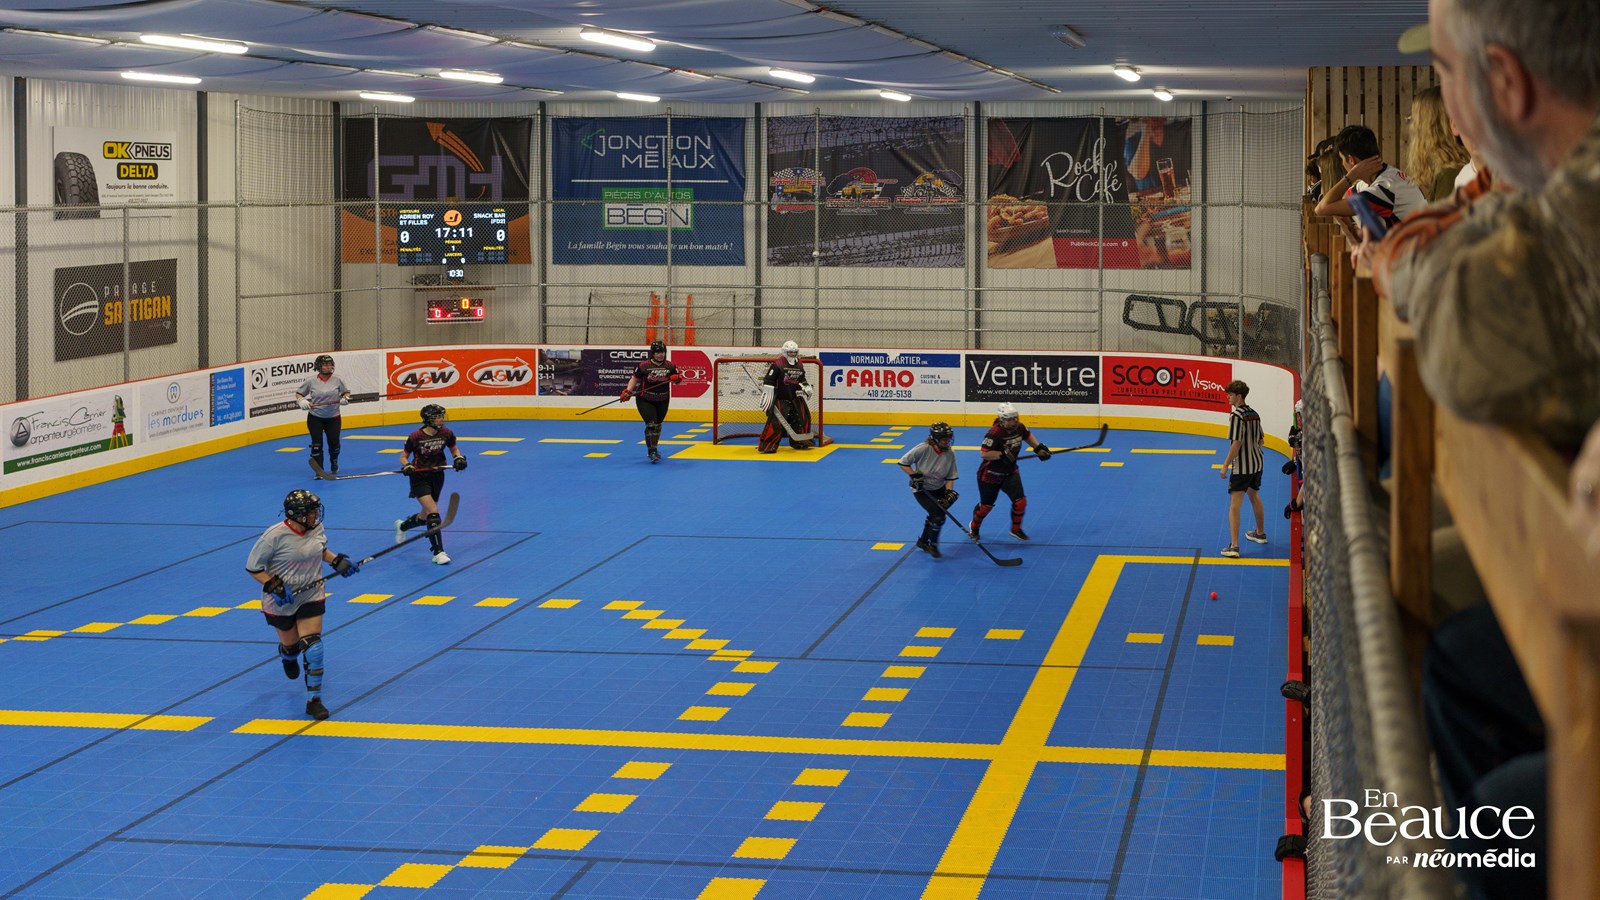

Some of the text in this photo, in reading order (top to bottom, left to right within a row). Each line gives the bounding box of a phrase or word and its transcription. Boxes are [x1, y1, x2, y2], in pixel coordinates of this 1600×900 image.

[103, 142, 170, 158] OK PNEUS
[120, 165, 155, 178] DELTA
[1040, 137, 1107, 197] Rock
[1076, 160, 1122, 204] Café
[400, 231, 410, 243] 0
[435, 227, 473, 238] 17:11
[496, 229, 506, 241] 0
[578, 241, 605, 250] famille
[689, 242, 703, 250] bon
[705, 242, 729, 250] match
[104, 281, 156, 297] PAAGE
[461, 298, 469, 309] 0
[609, 351, 649, 359] CAUCA
[850, 355, 885, 364] NORMAND
[271, 361, 317, 377] ESTAMP
[478, 369, 528, 383] A&W
[969, 360, 1096, 387] Venture
[1112, 364, 1186, 388] SCOOP
[402, 370, 455, 386] A&W
[846, 369, 915, 388] FALRO
[1188, 369, 1225, 391] Vision
[867, 390, 912, 398] 418 228-5138
[24, 411, 70, 431] Francis
[148, 413, 160, 430] les
[162, 405, 204, 427] mordues
